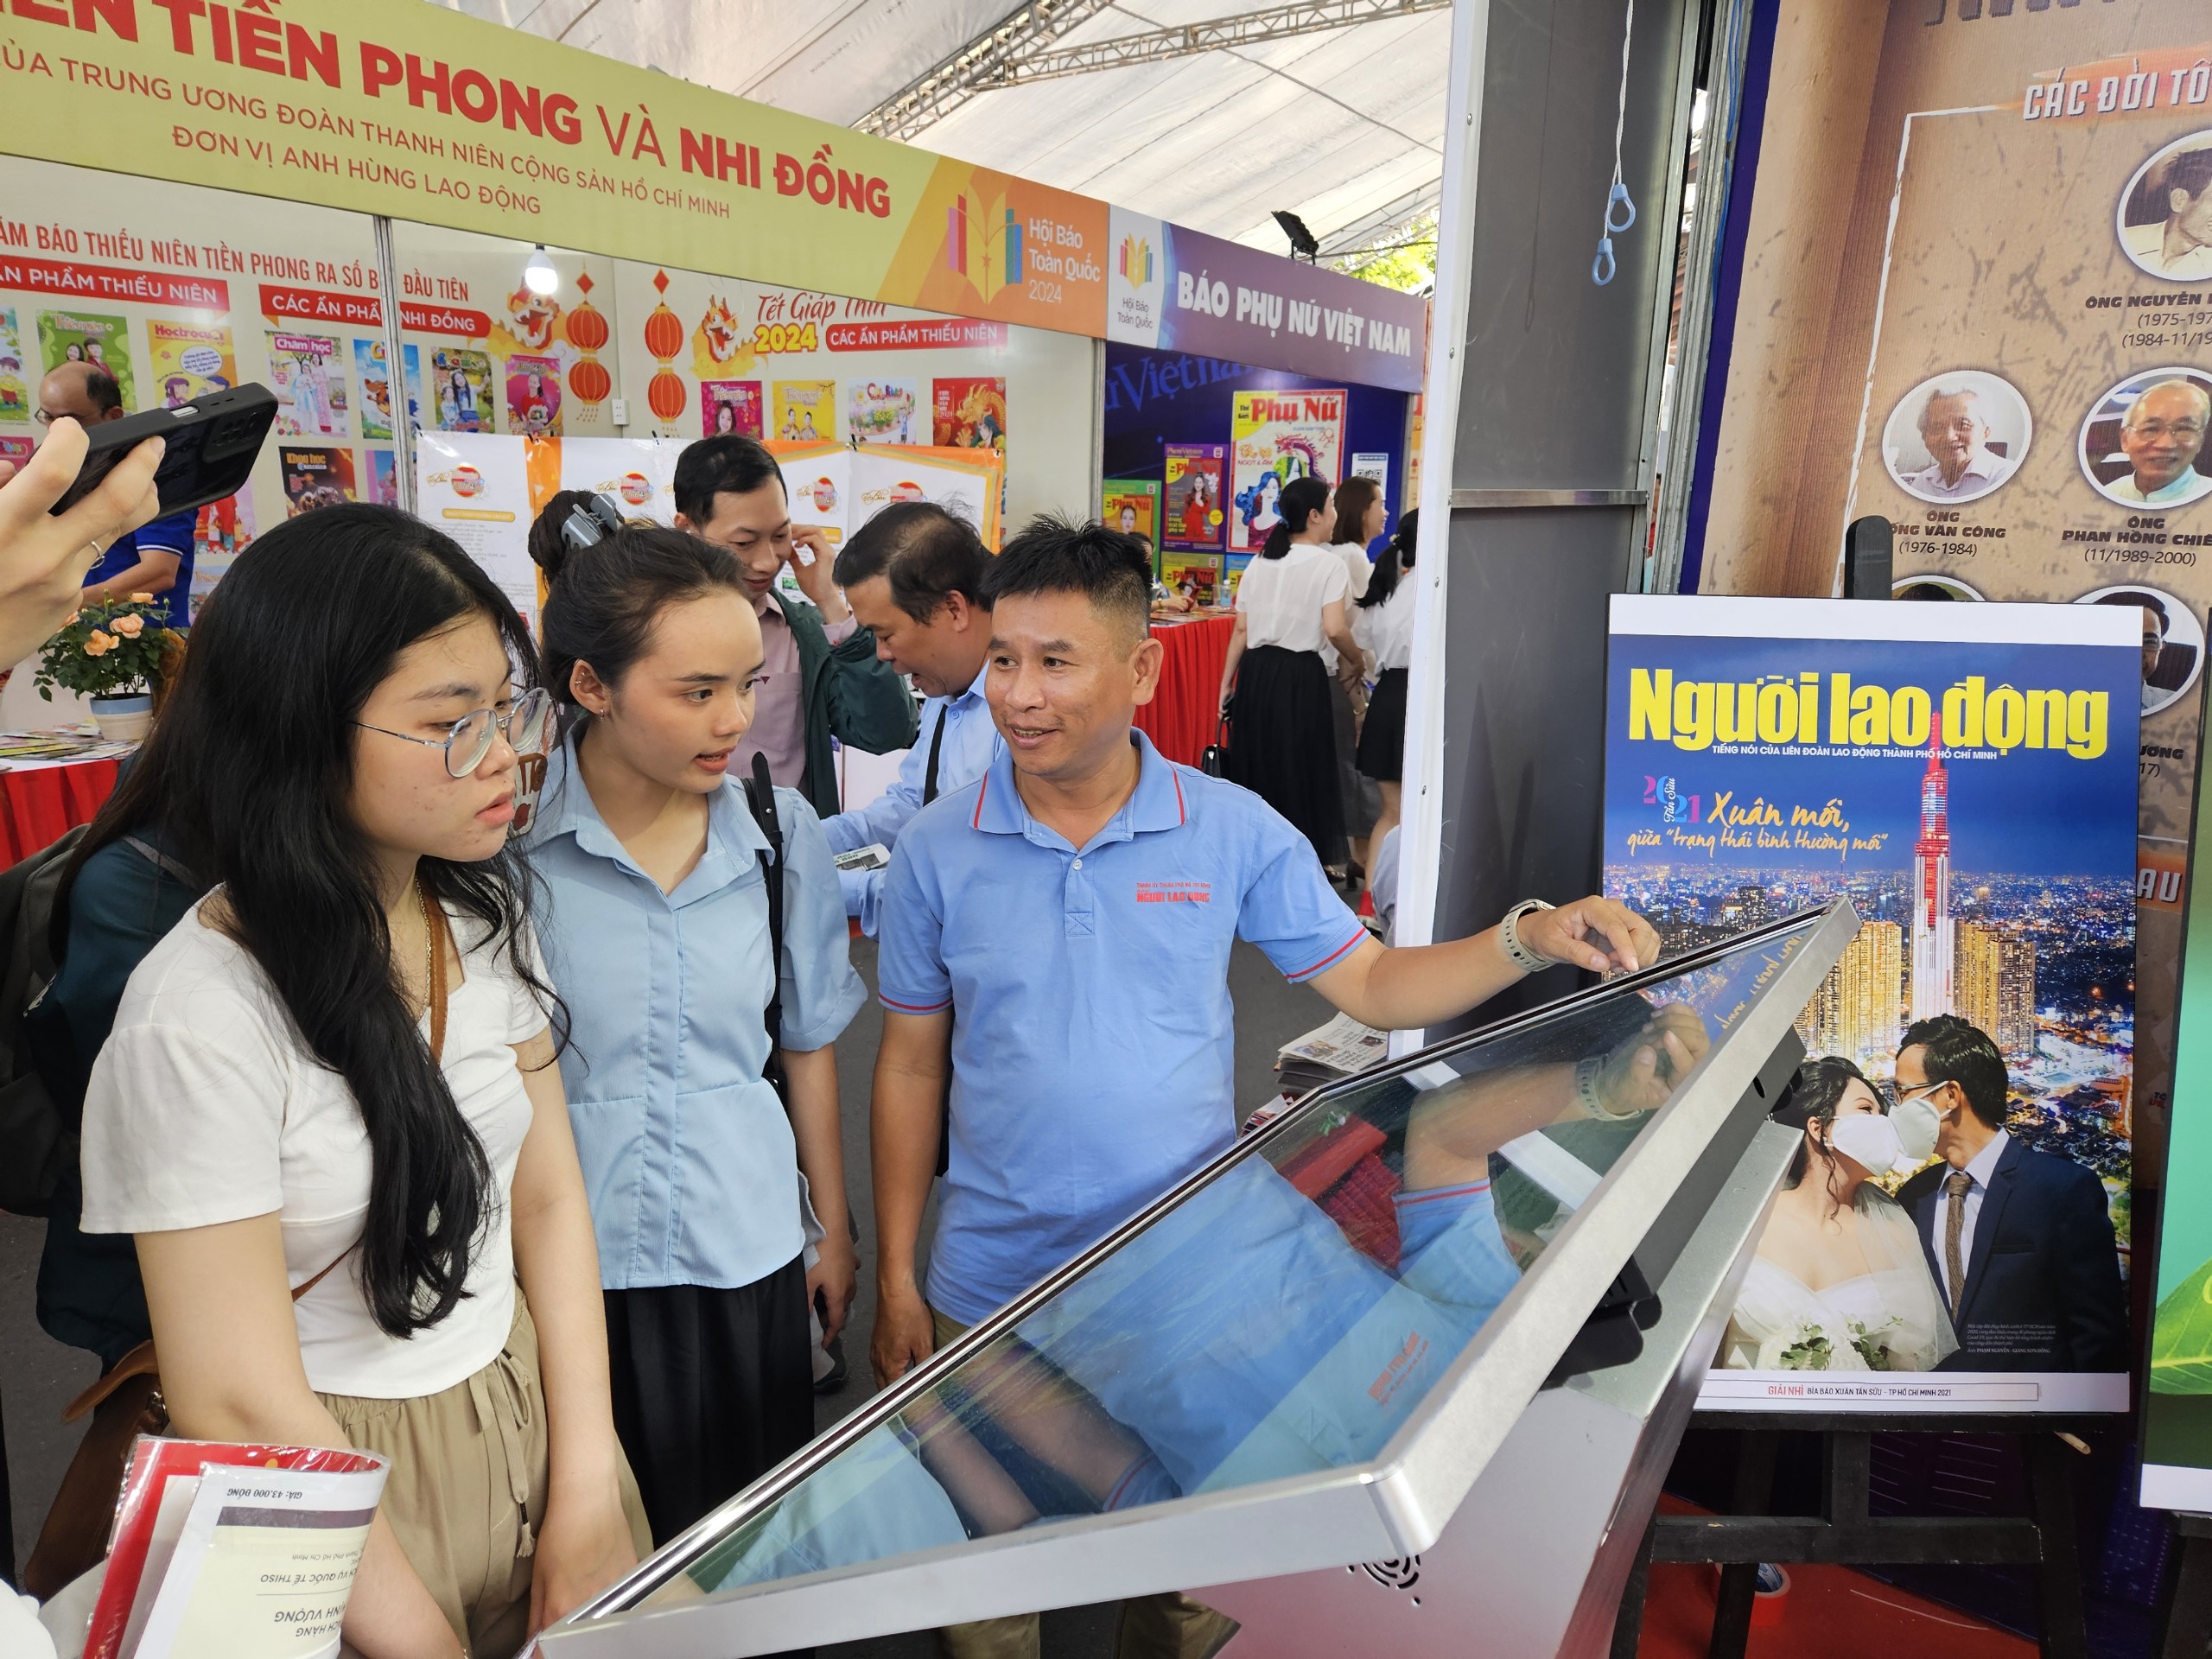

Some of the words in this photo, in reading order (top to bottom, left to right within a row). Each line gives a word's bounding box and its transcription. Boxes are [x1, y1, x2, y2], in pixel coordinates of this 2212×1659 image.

[2023, 67, 2089, 120] CÁC
[2097, 57, 2159, 113] ĐỜI
[2, 38, 54, 78] ỦA
[59, 56, 172, 100] TRUNG
[181, 82, 267, 120] ƯƠNG
[276, 103, 354, 138] ĐOÀN
[359, 121, 444, 157] THANH
[452, 141, 505, 171] NIÊN
[511, 155, 570, 184] CỘNG
[576, 168, 615, 195] SẢN
[622, 176, 648, 201] HỒ
[653, 186, 683, 209] CHÍ
[688, 194, 731, 219] MINH
[359, 41, 582, 145] PHONG
[595, 103, 668, 168] VÀ
[679, 126, 761, 190] NHI
[773, 143, 891, 219] ĐỒNG
[172, 125, 239, 158] ĐƠN
[245, 141, 275, 169] VỊ
[283, 146, 340, 176] ANH
[348, 157, 417, 190] HÙNG
[423, 174, 472, 200] LAO
[478, 184, 542, 214] ĐỘNG
[1029, 217, 1053, 246] Hội
[1056, 226, 1084, 250] Báo
[35, 222, 79, 254] BÁO
[83, 227, 144, 262] THIẾU
[150, 238, 198, 268] NIÊN
[202, 240, 245, 273] TIỀN
[250, 251, 310, 281] PHONG
[315, 261, 338, 285] RA
[342, 259, 364, 289] SỐ
[1029, 248, 1063, 276] Toàn
[1065, 252, 1101, 283] Quốc
[29, 265, 95, 290] PHẨM
[99, 275, 162, 298] THIẾU
[168, 283, 218, 303] NIÊN
[403, 267, 434, 297] ĐẦU
[436, 276, 469, 302] TIÊN
[1028, 279, 1063, 304] 2024
[271, 293, 310, 314] CÁC
[315, 295, 341, 317] ẤN
[346, 298, 383, 322] PHẨ
[757, 292, 786, 322] Tết
[790, 292, 837, 327] Giáp
[1177, 269, 1230, 318] BÁO
[1236, 287, 1284, 338] PHỤ
[1323, 307, 1365, 353] VIỆT
[1368, 319, 1411, 357] NAM
[2085, 296, 2123, 308] ÔNG
[401, 309, 427, 327] NHI
[430, 309, 476, 332] ĐỒNG
[753, 322, 818, 354] 2024
[830, 329, 856, 346] CÁC
[859, 327, 878, 345] ẤN
[881, 323, 918, 344] PHẨM
[922, 322, 960, 342] THIẾU
[964, 322, 998, 340] NIÊN
[1251, 397, 1300, 425] Phụ
[1304, 397, 1339, 423] Nữ
[1926, 510, 1961, 522] ÔNG
[2127, 515, 2165, 530] ÔNG
[1891, 522, 1920, 535] ỐNG
[1924, 524, 1958, 537] VĂN
[1961, 525, 2006, 538] CÔNG
[2062, 530, 2112, 543] PHAN
[2117, 530, 2167, 545] HỒNG
[1899, 541, 1978, 557] (1976-1984)
[2084, 549, 2196, 567] (11/1989-2000)
[1629, 668, 1820, 751] Người
[1829, 672, 1932, 747] lao
[1942, 676, 2109, 760] động
[1712, 743, 1739, 754] TIẾNG
[1740, 744, 1758, 755] NÓI
[1760, 743, 1781, 756] CỦA
[1782, 745, 1801, 756] LIÊN
[1802, 745, 1830, 757] ĐOÀN
[1832, 748, 1850, 757] LAO
[1852, 746, 1881, 759] ĐỘNG
[1882, 747, 1914, 758] THÀNH
[1915, 747, 1936, 759] PHỐ
[1936, 747, 1952, 759] HỒ
[1953, 749, 1971, 760] CHÍ
[1973, 751, 1997, 760] MINH
[2139, 762, 2161, 778] 17)
[1707, 791, 1783, 829] Xuân
[1790, 798, 1850, 833] mới,
[1627, 829, 1662, 857] giữa
[1720, 826, 1753, 849] thái
[1758, 828, 1791, 849] bình
[1795, 830, 1847, 861] thường
[1167, 892, 1185, 902] LAO
[1768, 1383, 1786, 1395] GIẢI
[1788, 1384, 1804, 1395] NHÌ
[1820, 1387, 1834, 1395] BÁO
[1835, 1387, 1854, 1395] XUÂN
[1855, 1387, 1868, 1395] TÂN
[1869, 1387, 1882, 1396] SỬU
[253, 1490, 283, 1499] 43.000
[284, 1491, 302, 1501] GIÁ:
[260, 1573, 291, 1584] THISO
[292, 1574, 306, 1586] TẾ
[308, 1573, 336, 1586] QUỐC
[338, 1571, 348, 1580] VỤ
[274, 1608, 322, 1623] VƯỢNG
[296, 1624, 327, 1637] HÀNG
